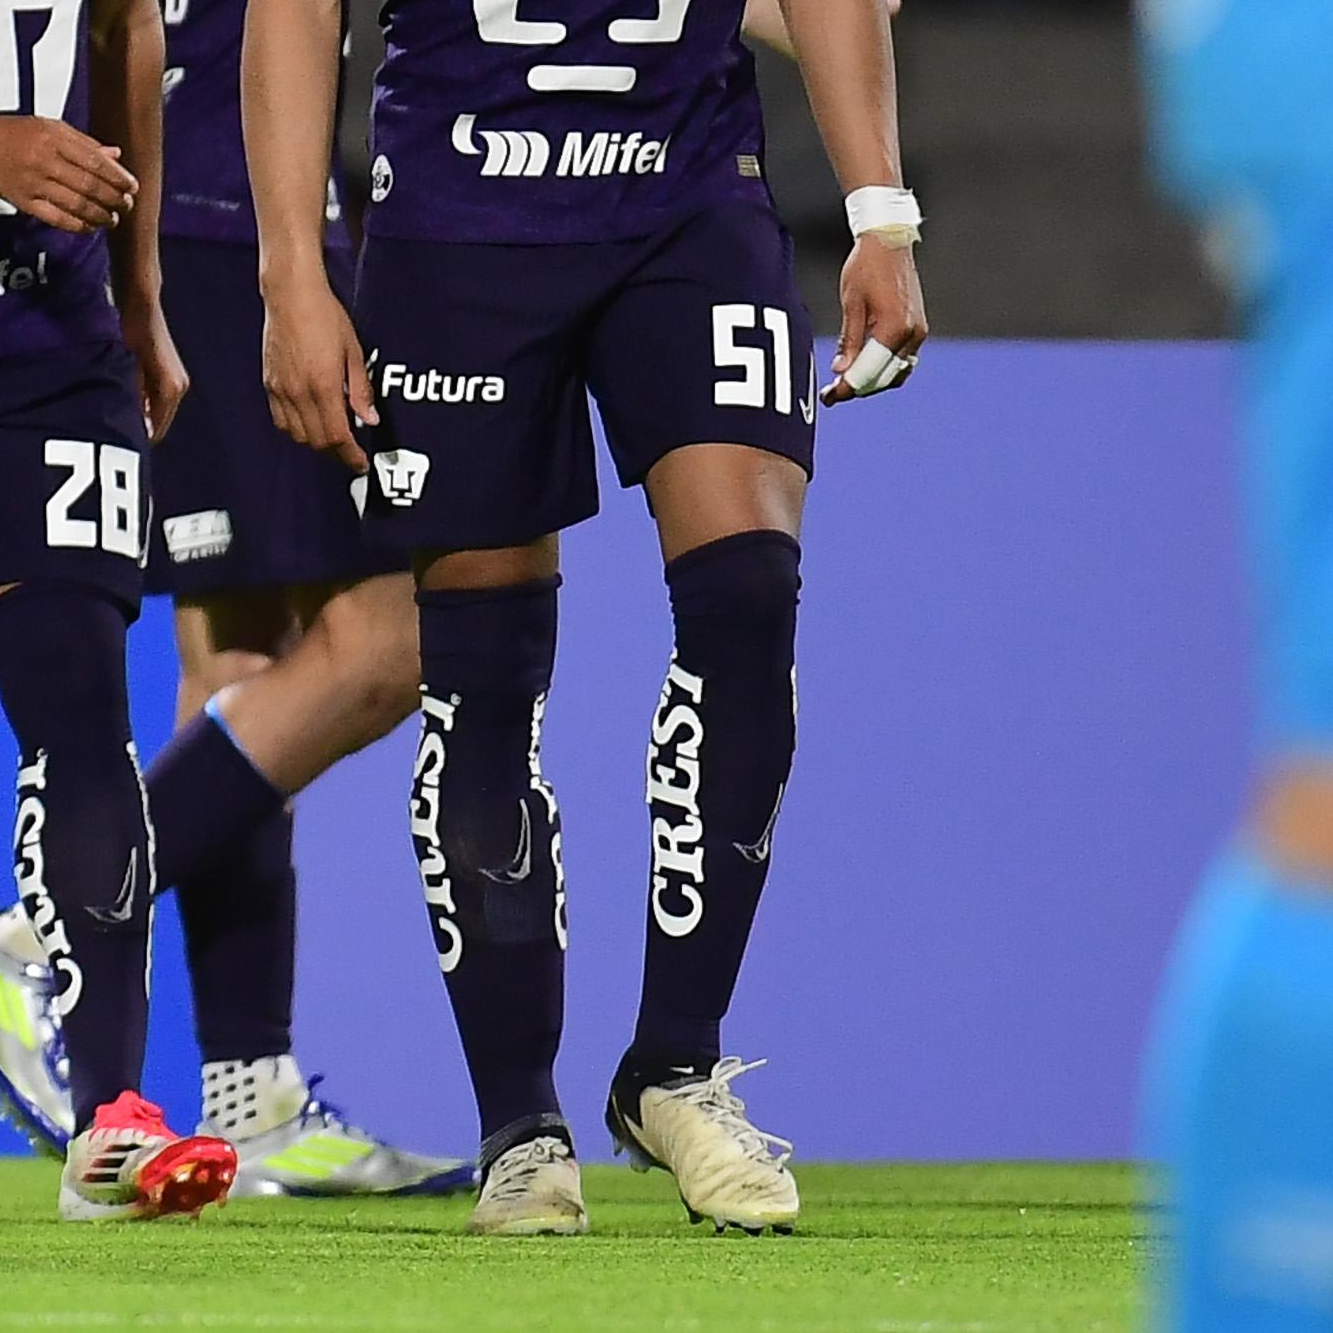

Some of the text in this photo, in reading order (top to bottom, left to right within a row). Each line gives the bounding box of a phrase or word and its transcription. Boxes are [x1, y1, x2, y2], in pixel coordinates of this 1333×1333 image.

[555, 131, 673, 177] Mifel
[381, 364, 505, 403] Futura
[712, 303, 792, 415] 51
[44, 439, 140, 558] 28
